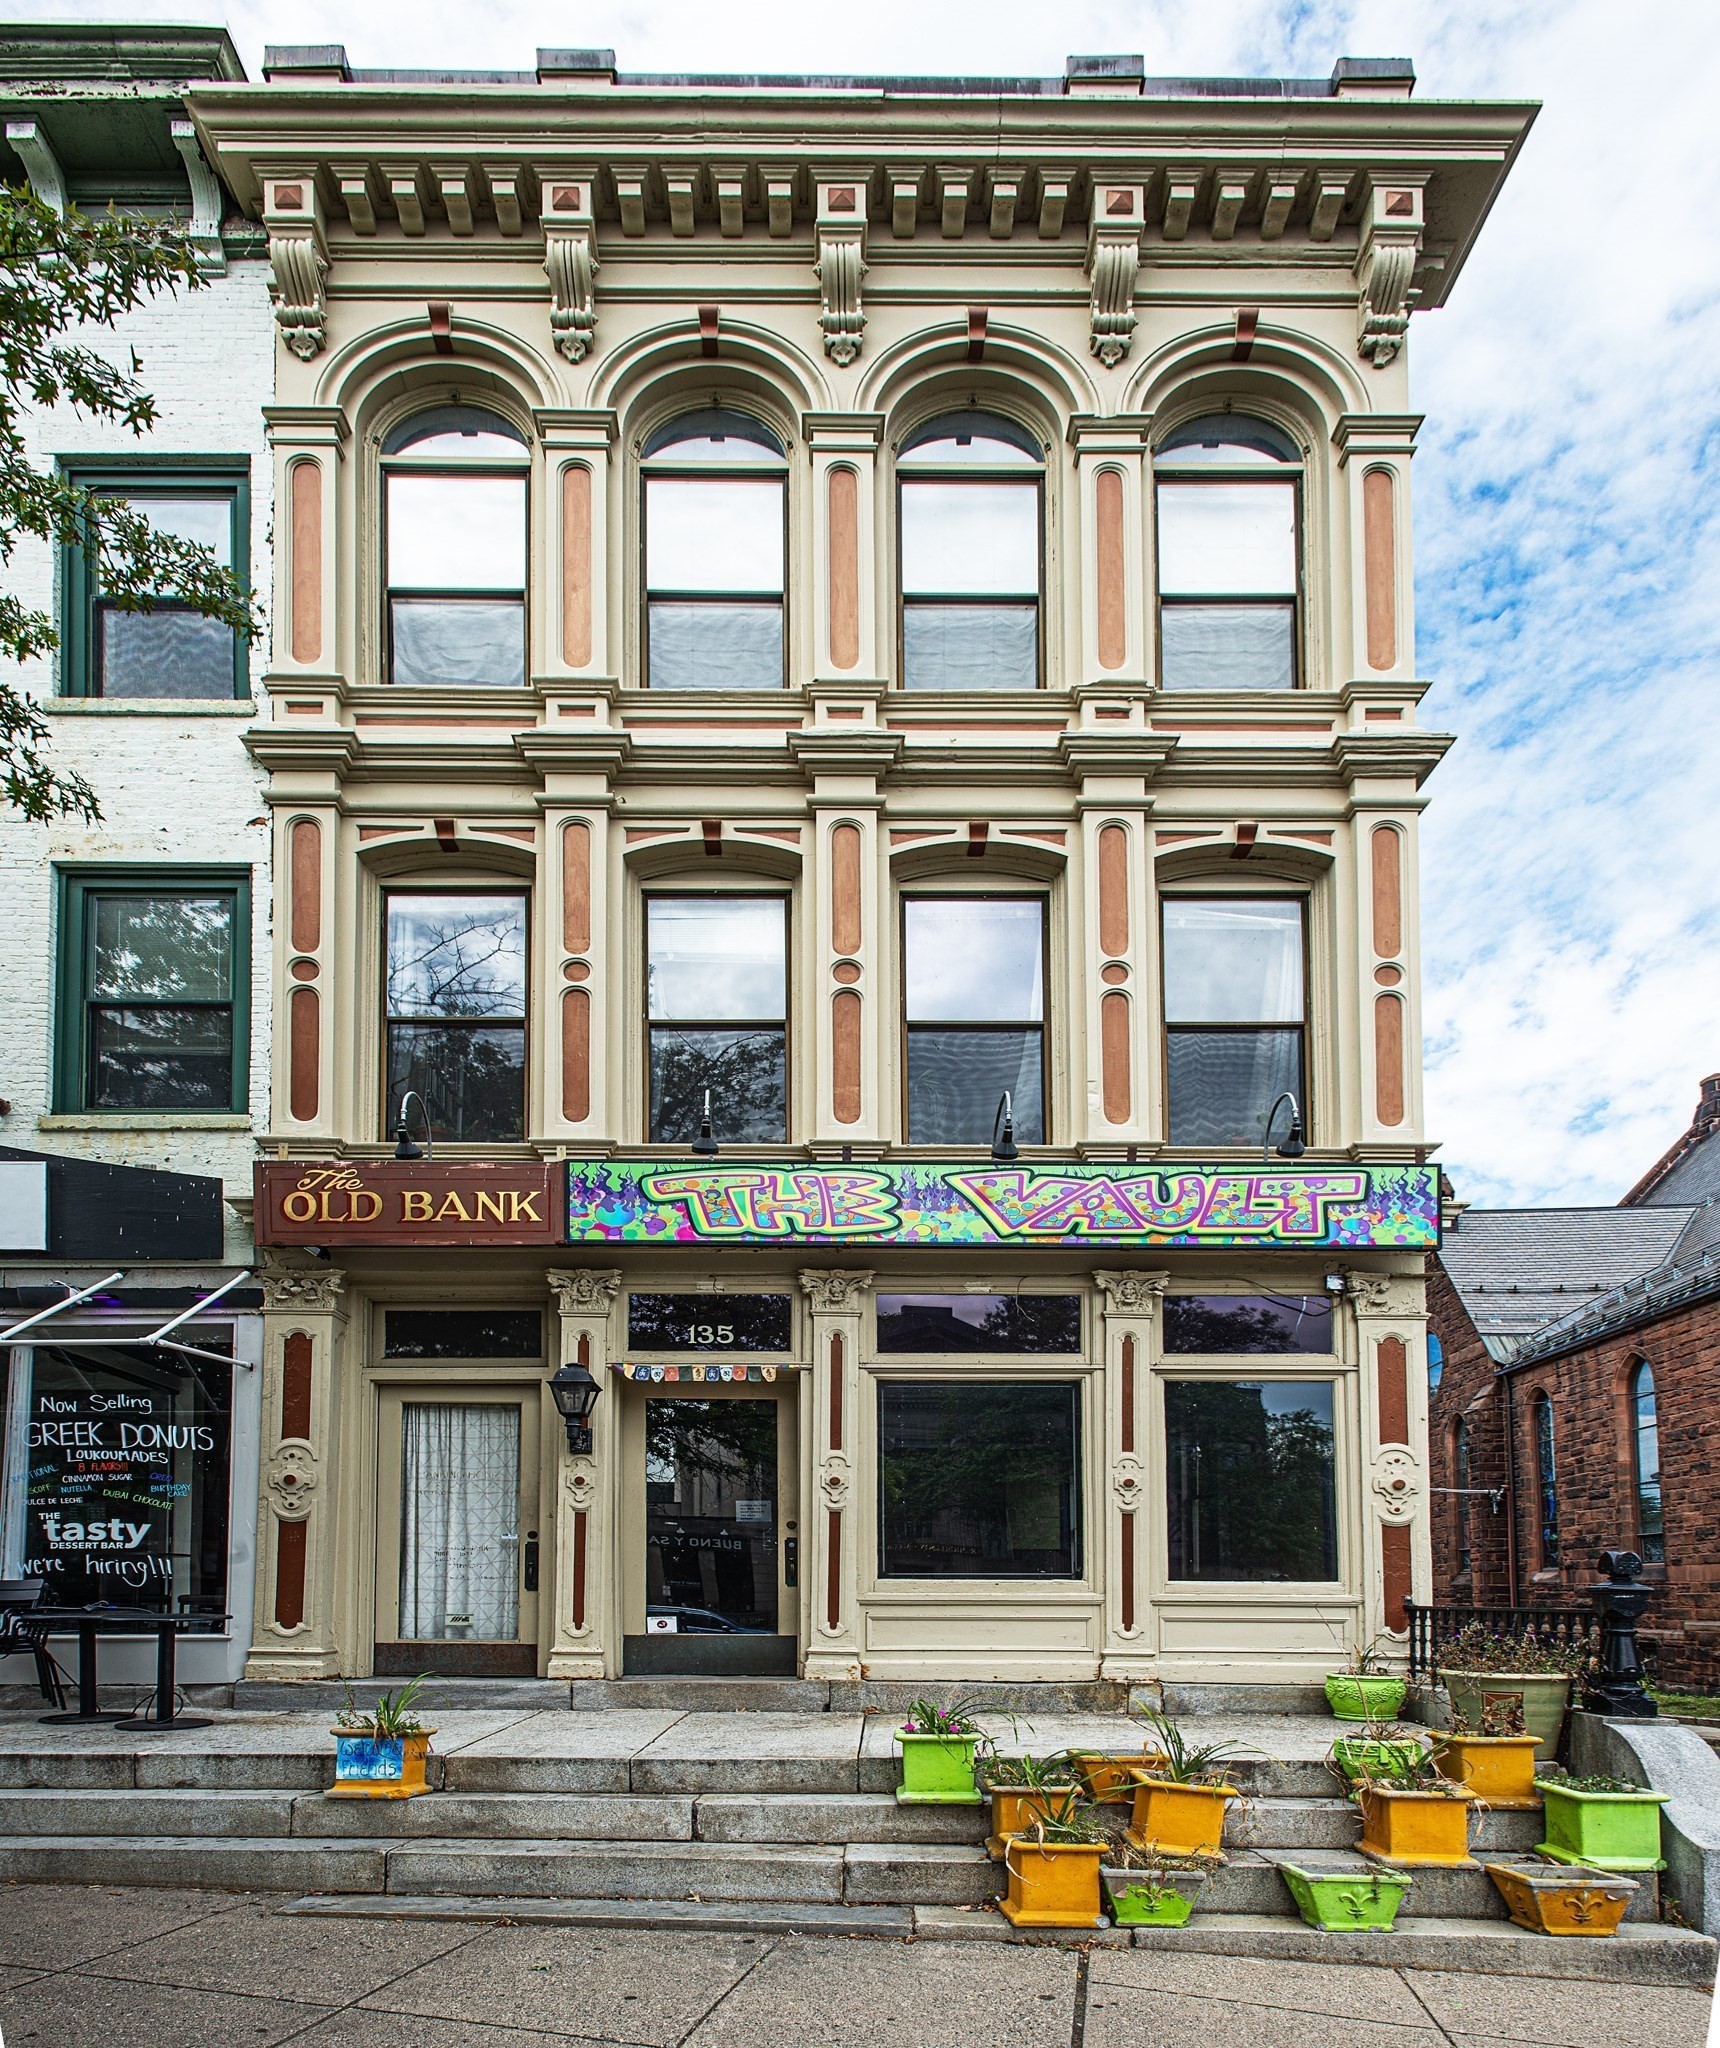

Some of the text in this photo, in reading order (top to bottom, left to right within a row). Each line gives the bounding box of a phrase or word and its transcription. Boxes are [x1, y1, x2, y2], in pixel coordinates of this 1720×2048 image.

[297, 1169, 363, 1190] The
[283, 1191, 543, 1223] OLD BANK
[640, 1167, 1368, 1240] THE VAULT
[687, 1324, 735, 1344] 135
[89, 1394, 152, 1415] Selling
[22, 1422, 214, 1451] GREEK DONUTS
[66, 1449, 168, 1464] LOUKOUMADES
[62, 1473, 133, 1483] CINNAMON SUGAR
[60, 1484, 93, 1493] NUTELLA
[150, 1483, 192, 1493] BIRTHDAY
[48, 1497, 57, 1505] DE
[102, 1488, 175, 1510] DUBAI CHOCOLATE
[38, 1512, 61, 1520] THE
[43, 1518, 151, 1549] tasty
[101, 1541, 123, 1549] BAR
[17, 1557, 65, 1575] we're
[342, 1759, 396, 1776] Friends
